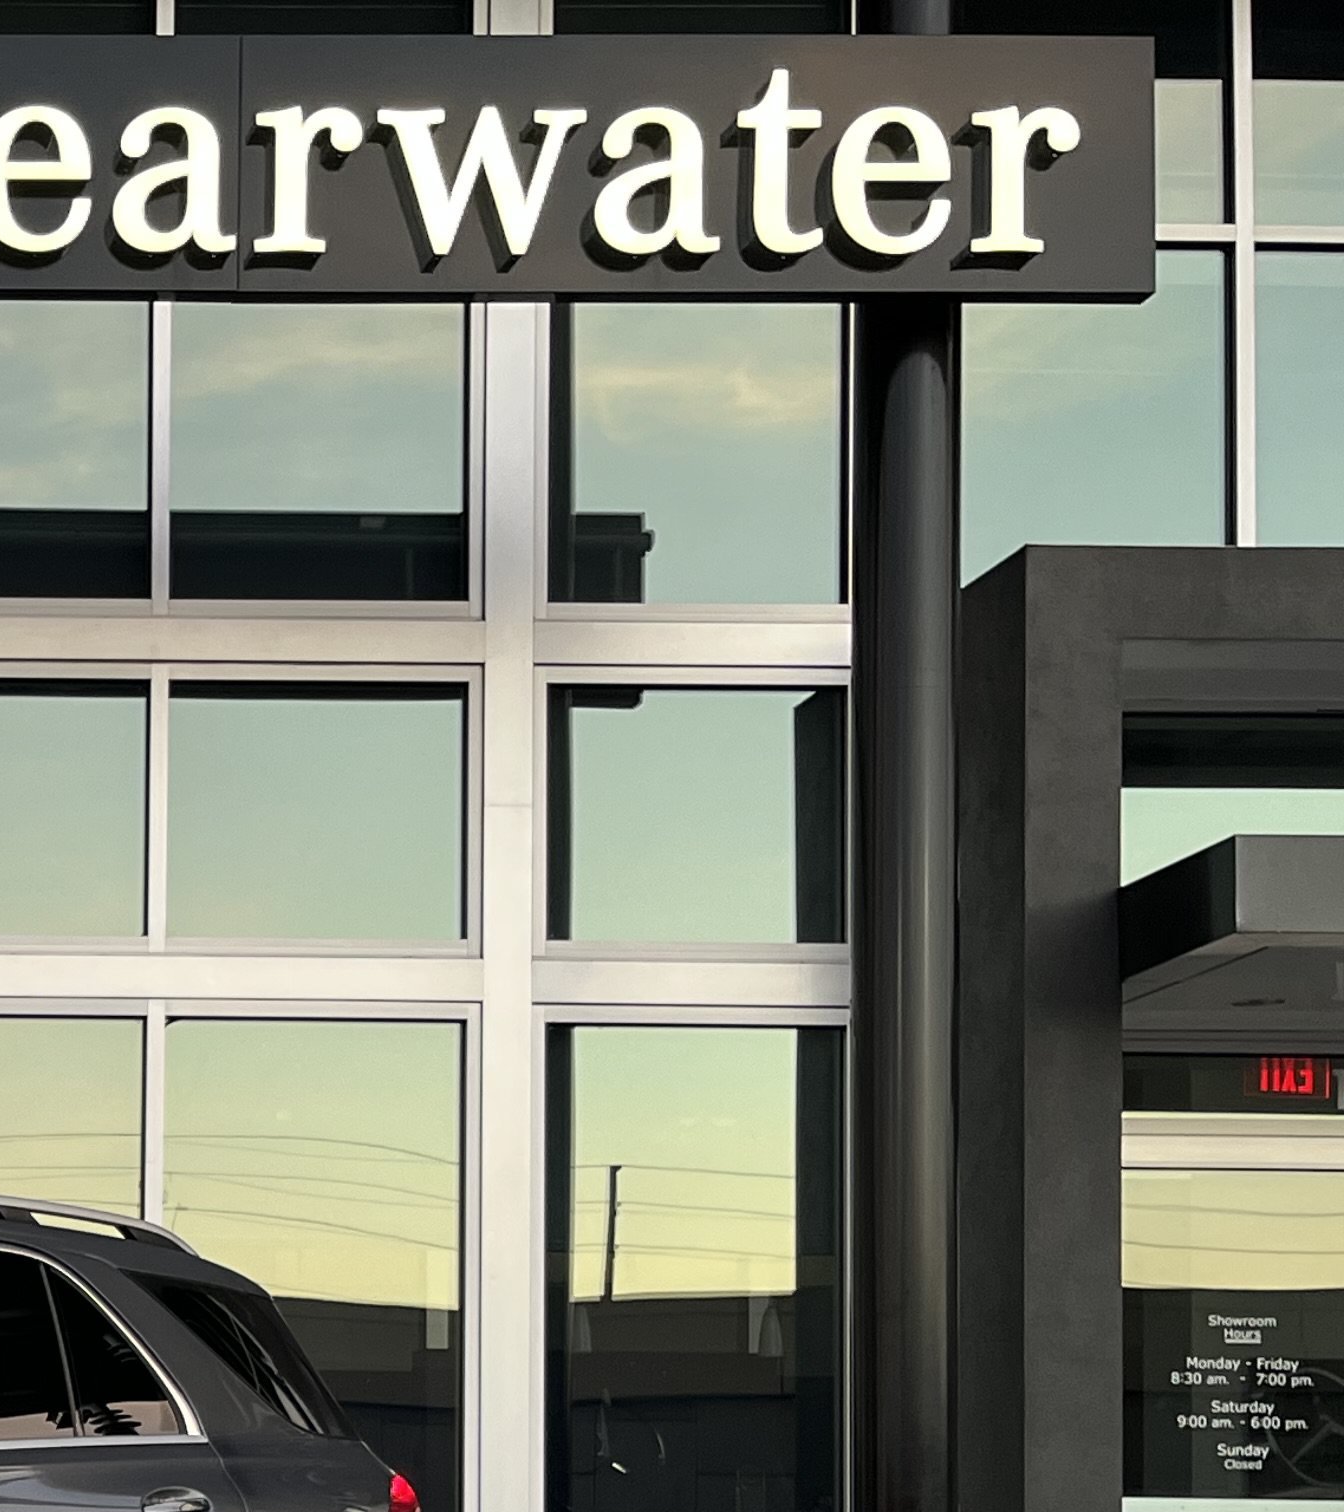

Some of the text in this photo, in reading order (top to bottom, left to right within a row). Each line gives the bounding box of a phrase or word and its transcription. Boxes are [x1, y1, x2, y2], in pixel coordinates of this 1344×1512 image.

[1207, 1314, 1277, 1327] Showroom
[1223, 1328, 1262, 1340] Hours
[1186, 1356, 1241, 1371] Monday
[1256, 1357, 1300, 1373] Friday
[1170, 1371, 1203, 1385] 8:30
[1256, 1373, 1287, 1386] 7:00
[1211, 1400, 1275, 1416] Saturday
[1176, 1415, 1208, 1428] 9:00
[1250, 1416, 1281, 1429] 6:00
[1216, 1443, 1270, 1460] Sunday
[1223, 1459, 1263, 1470] Closed
